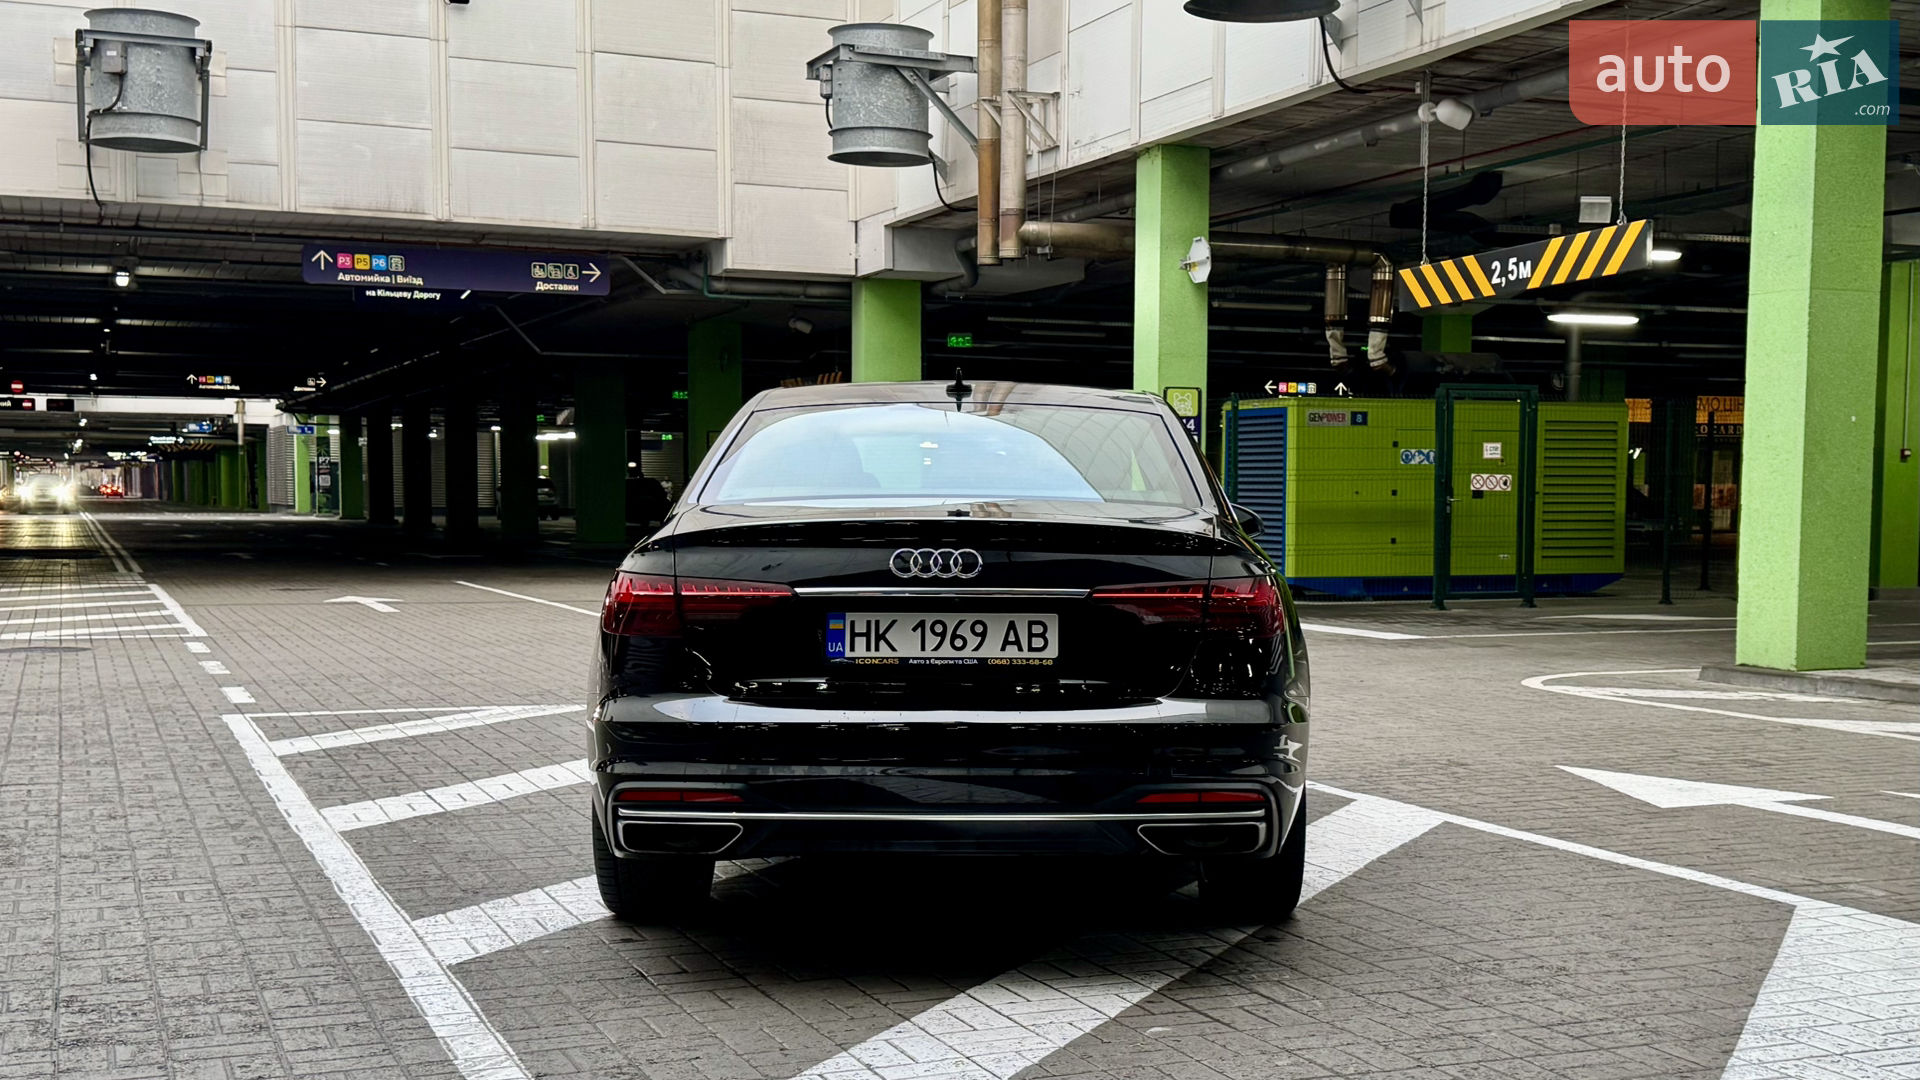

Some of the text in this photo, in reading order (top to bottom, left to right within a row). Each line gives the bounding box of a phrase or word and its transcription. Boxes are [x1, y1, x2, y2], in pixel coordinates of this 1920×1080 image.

[339, 257, 386, 267] P3 P5 P6
[337, 272, 391, 283] Автомийка
[396, 275, 424, 285] Виїзд
[535, 281, 579, 291] Доставки
[377, 289, 412, 299] Кільцеву
[413, 290, 441, 300] Дорогу
[849, 619, 1050, 652] HK 1969 AB
[828, 642, 844, 652] UA
[1011, 658, 1053, 666] 333-68-68
